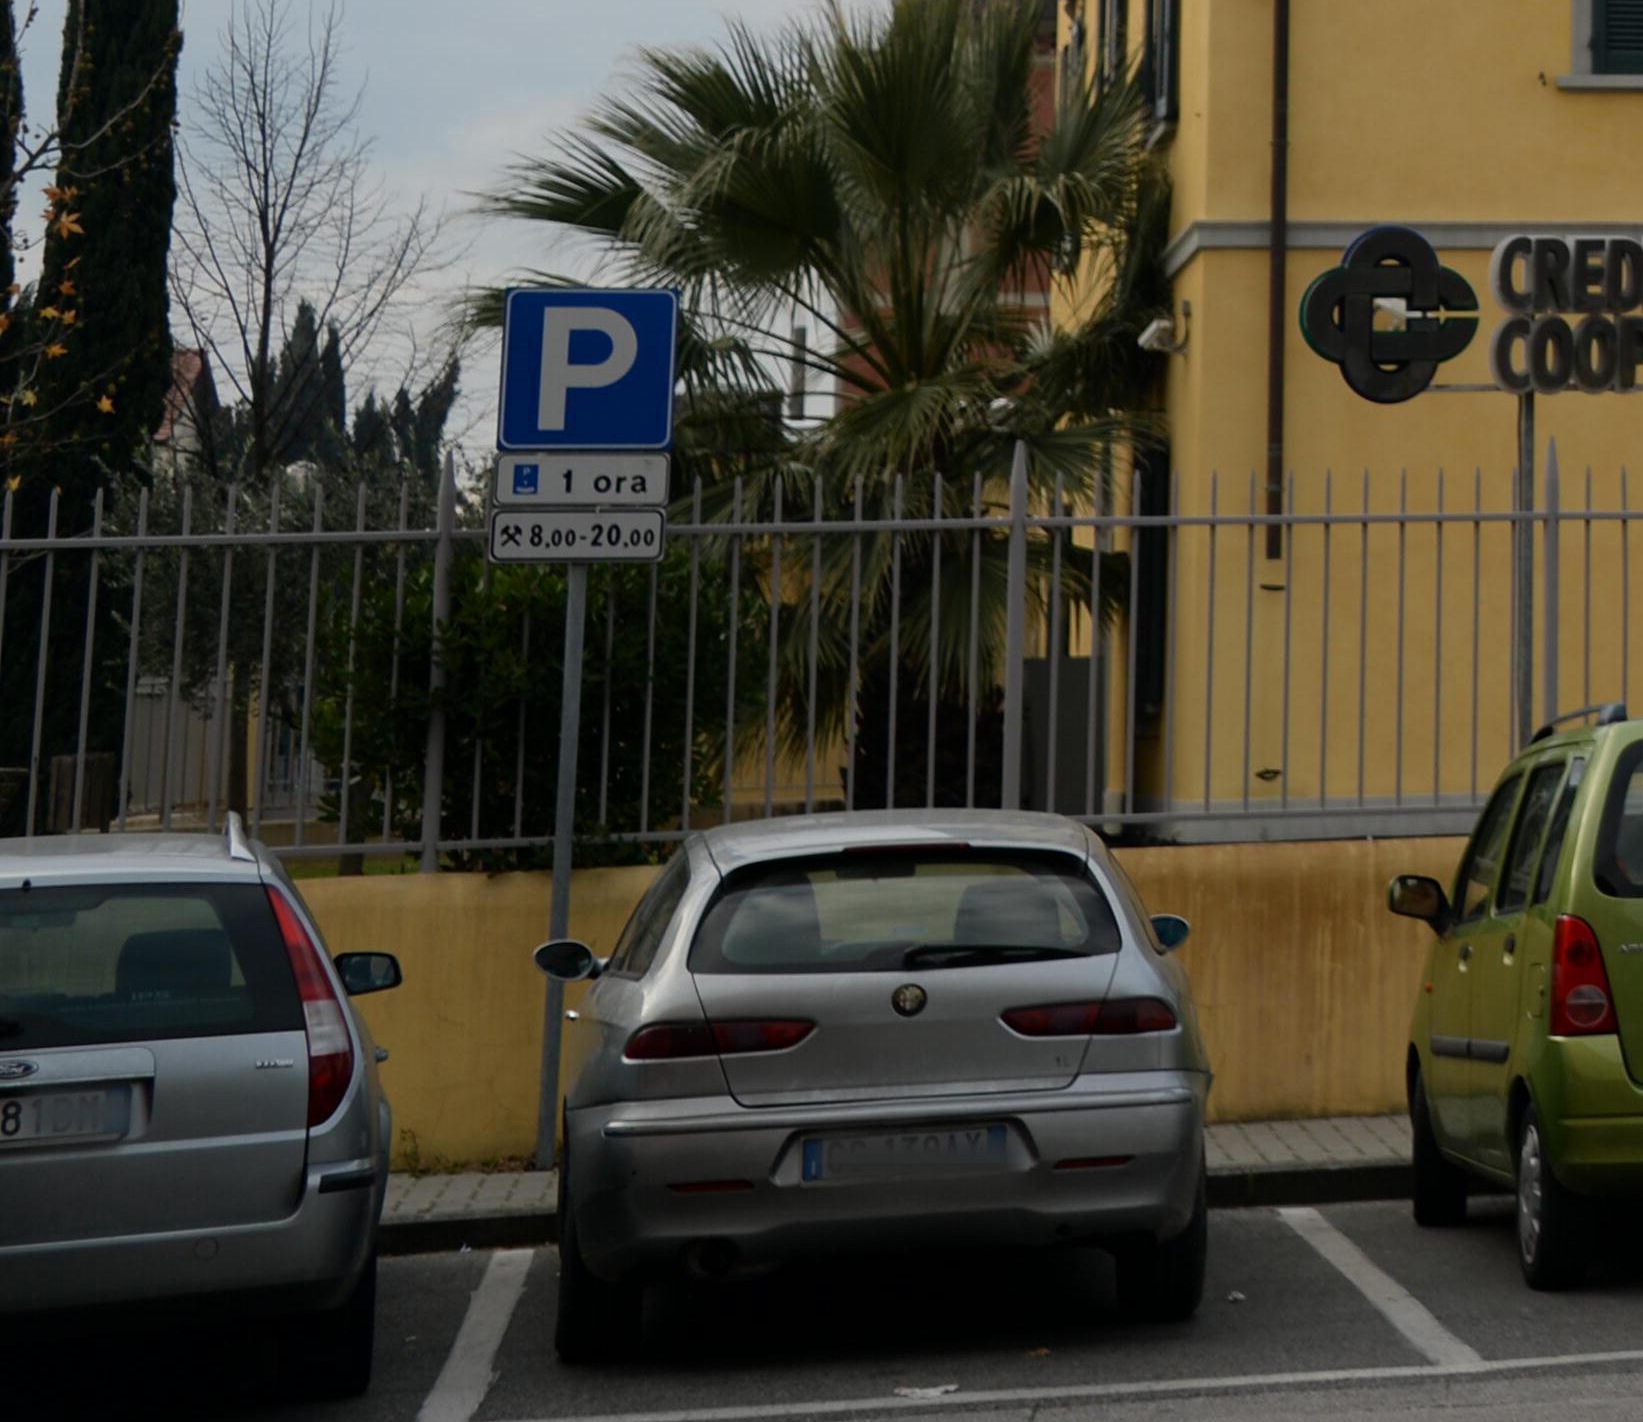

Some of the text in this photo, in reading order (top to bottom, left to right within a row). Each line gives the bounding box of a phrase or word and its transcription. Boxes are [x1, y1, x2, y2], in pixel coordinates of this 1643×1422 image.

[537, 306, 638, 431] P
[562, 469, 573, 494] 1
[593, 473, 647, 494] ora
